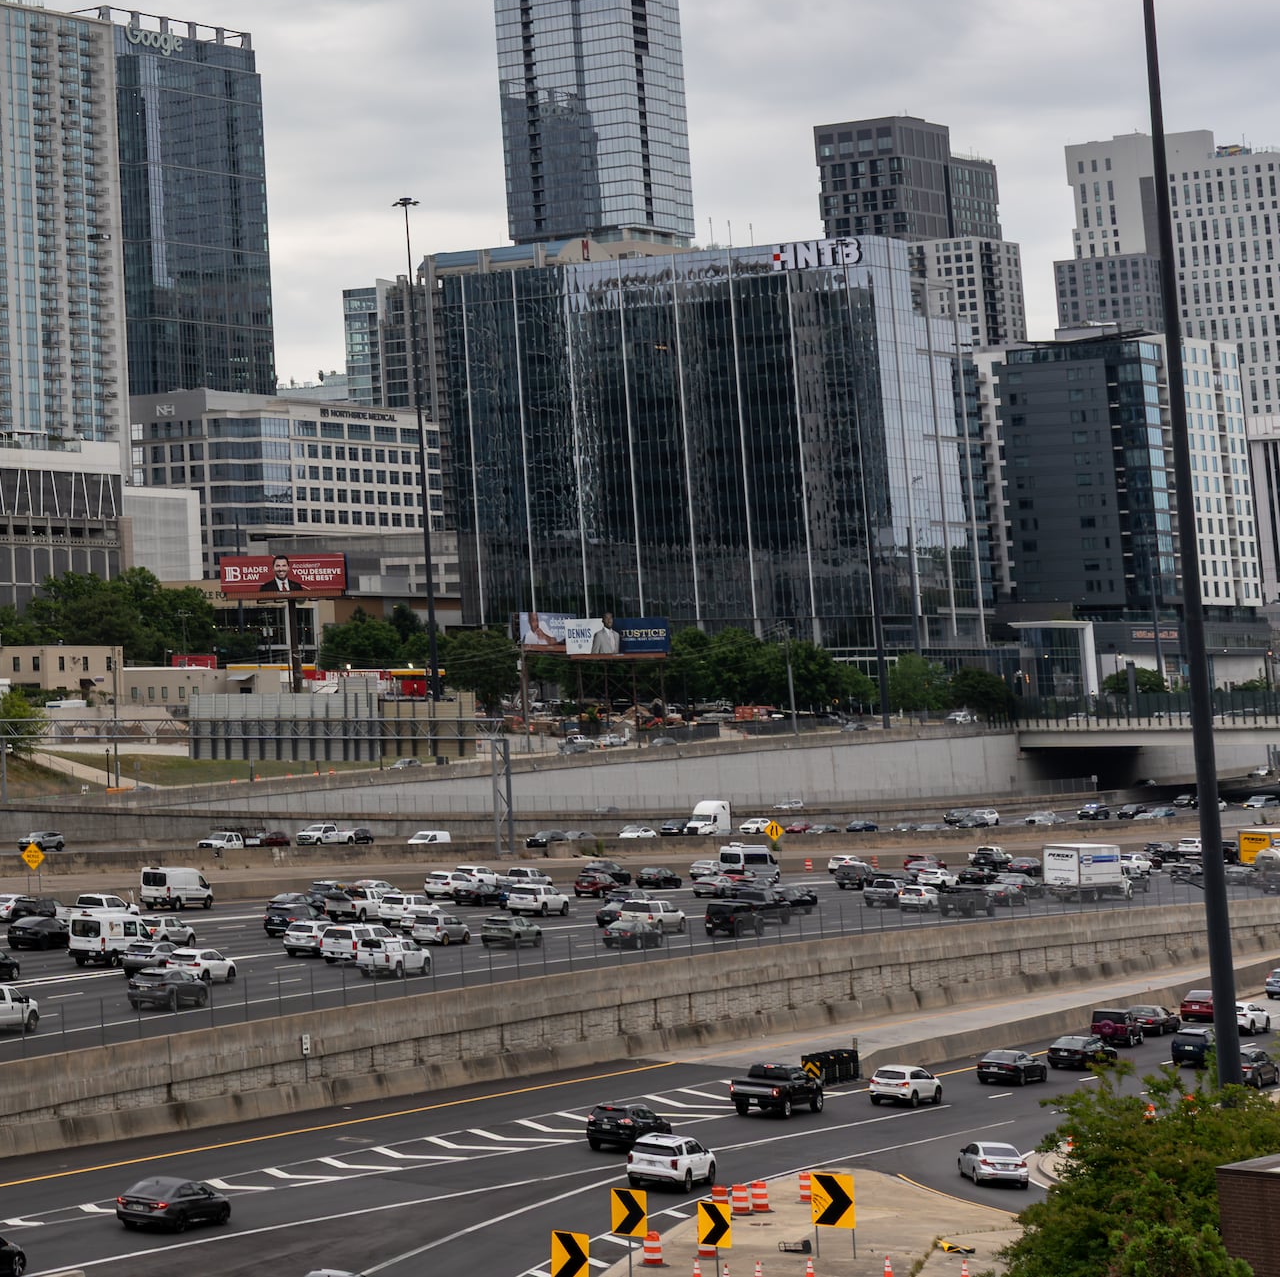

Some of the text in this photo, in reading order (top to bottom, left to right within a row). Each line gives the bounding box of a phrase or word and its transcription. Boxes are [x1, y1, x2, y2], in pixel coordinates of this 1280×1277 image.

[126, 21, 183, 56] Google
[772, 238, 861, 270] HNTB
[331, 410, 368, 420] NORTHSIDE
[369, 413, 397, 422] MEDICAL
[242, 566, 269, 574] BADER
[567, 628, 591, 639] DENNIS
[621, 628, 667, 638] JUSTICE
